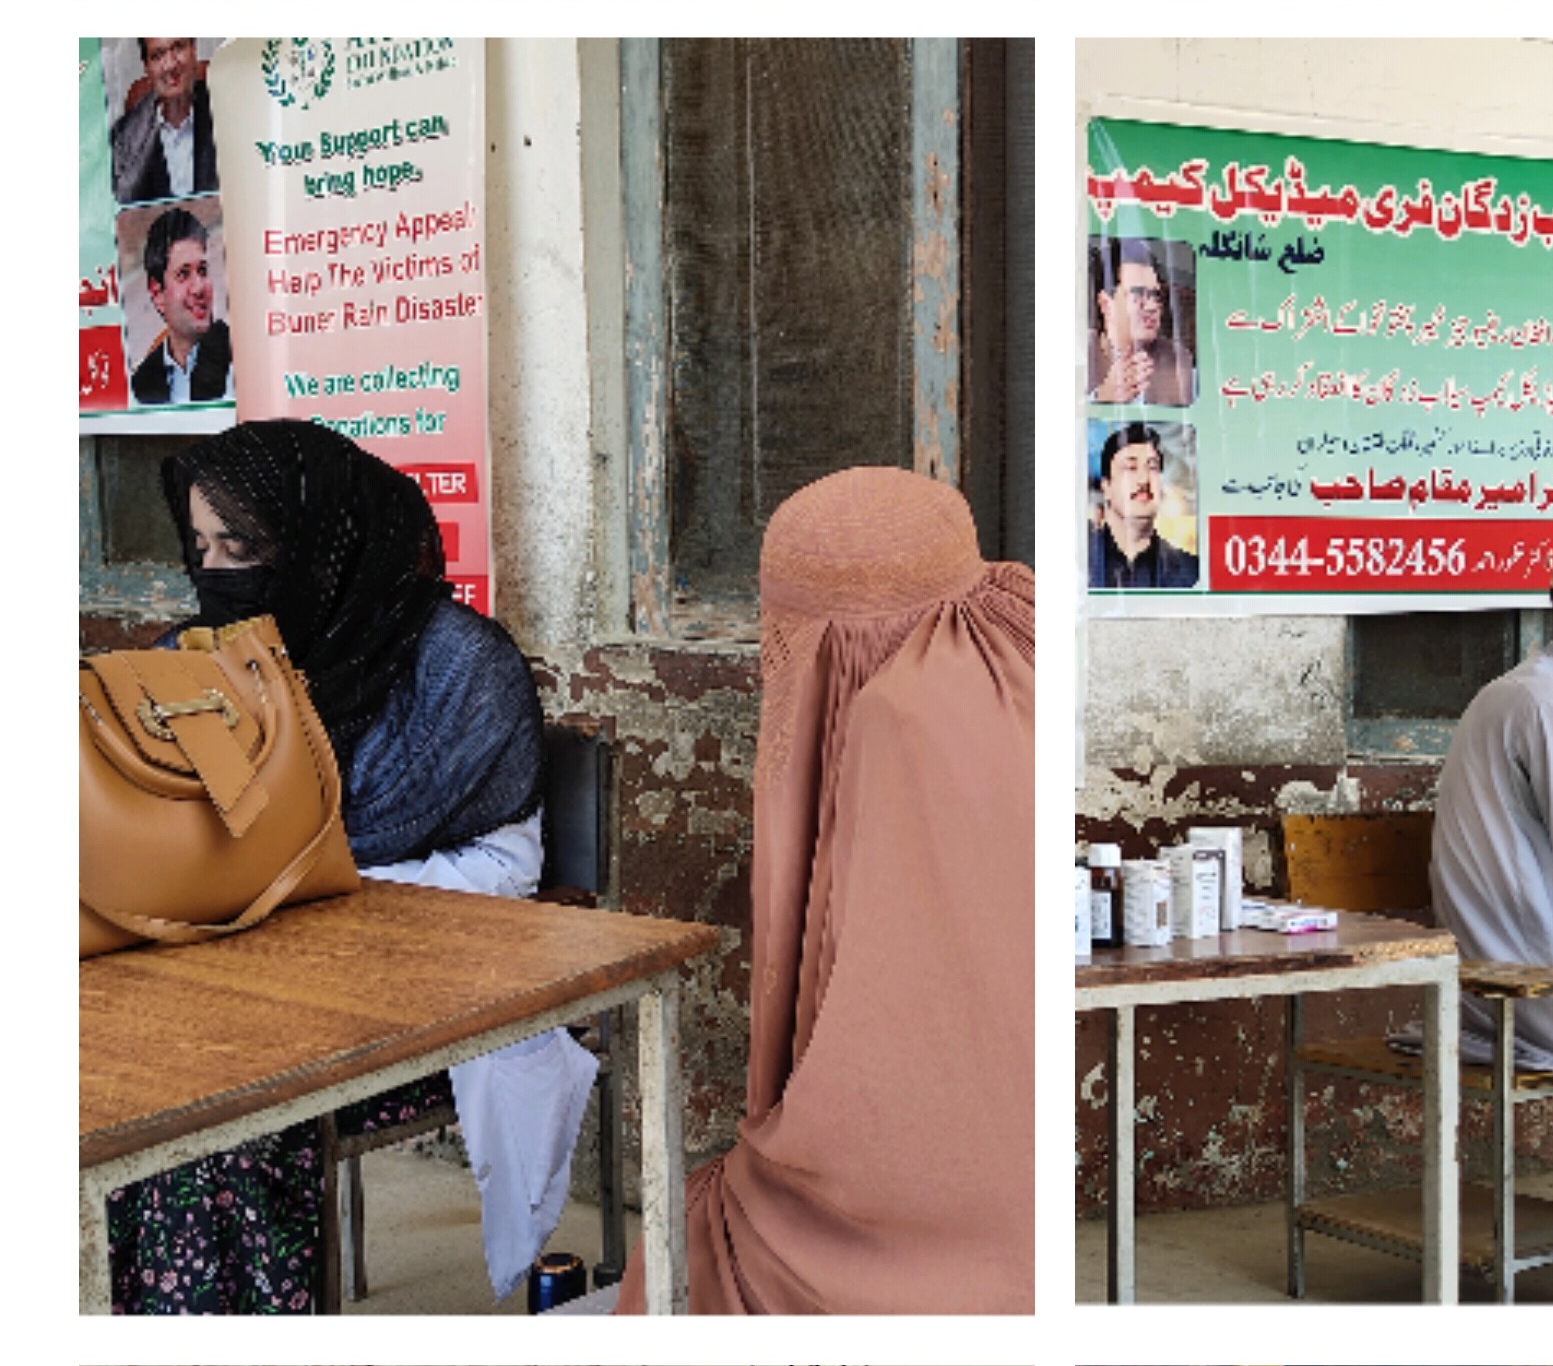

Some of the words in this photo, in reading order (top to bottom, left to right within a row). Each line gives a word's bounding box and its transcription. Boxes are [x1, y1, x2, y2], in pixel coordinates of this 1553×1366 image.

[255, 140, 315, 167] Your
[319, 119, 403, 161] Support
[405, 115, 450, 141] can
[304, 171, 357, 199] bring
[1087, 159, 1208, 226] کیمپ
[1210, 155, 1361, 230] میڈیکل
[1363, 176, 1435, 237] فری
[263, 220, 388, 255] Emergency
[395, 201, 476, 244] Appeal:
[1436, 176, 1533, 248] زدگان
[267, 269, 323, 297] Help
[327, 263, 366, 287] The
[370, 253, 454, 285] Victims
[461, 244, 481, 274] of
[1277, 235, 1326, 274] ضلع
[267, 311, 336, 336] Buner
[343, 300, 389, 330] Rain
[395, 291, 484, 325] Disaster
[284, 371, 321, 398] We
[323, 374, 356, 395] are
[359, 361, 461, 393] collecting
[415, 407, 447, 433] for
[1310, 466, 1408, 508] صاحب
[1408, 468, 1472, 514] مقام
[1473, 470, 1537, 512] امیر
[1224, 534, 1466, 577] 0344-5582456
